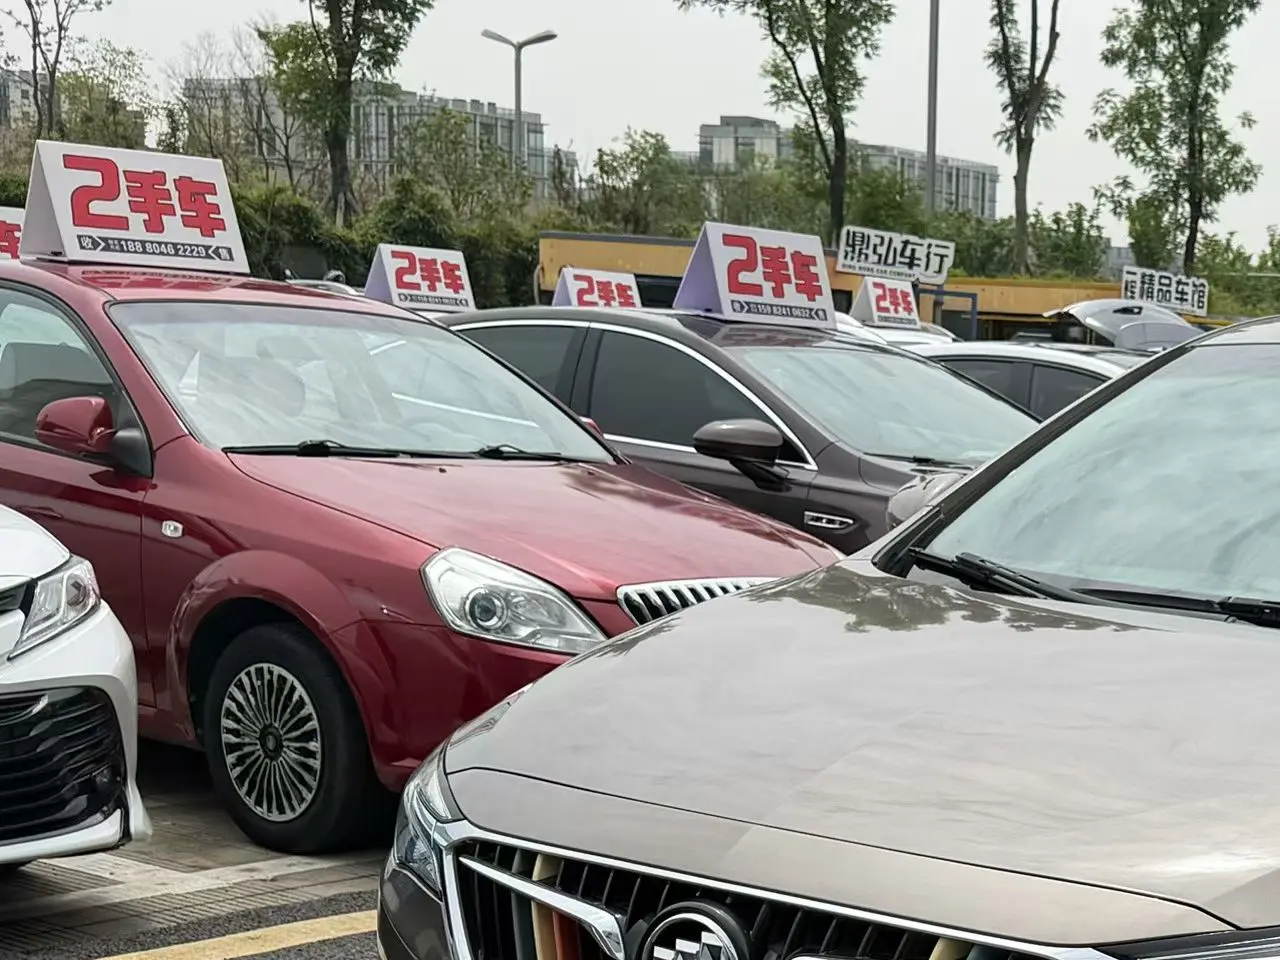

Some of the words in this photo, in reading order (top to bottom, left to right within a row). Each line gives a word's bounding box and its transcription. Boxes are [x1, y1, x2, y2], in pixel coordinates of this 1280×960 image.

[62, 153, 226, 238] 2手车
[120, 239, 143, 252] 188
[145, 242, 175, 255] 8046
[177, 245, 206, 257] 2229
[721, 233, 824, 302] 2手车
[843, 228, 950, 274] 鼎弘车行
[390, 250, 465, 294] 2手车
[572, 274, 636, 307] 2手车
[872, 282, 914, 316] 2手车
